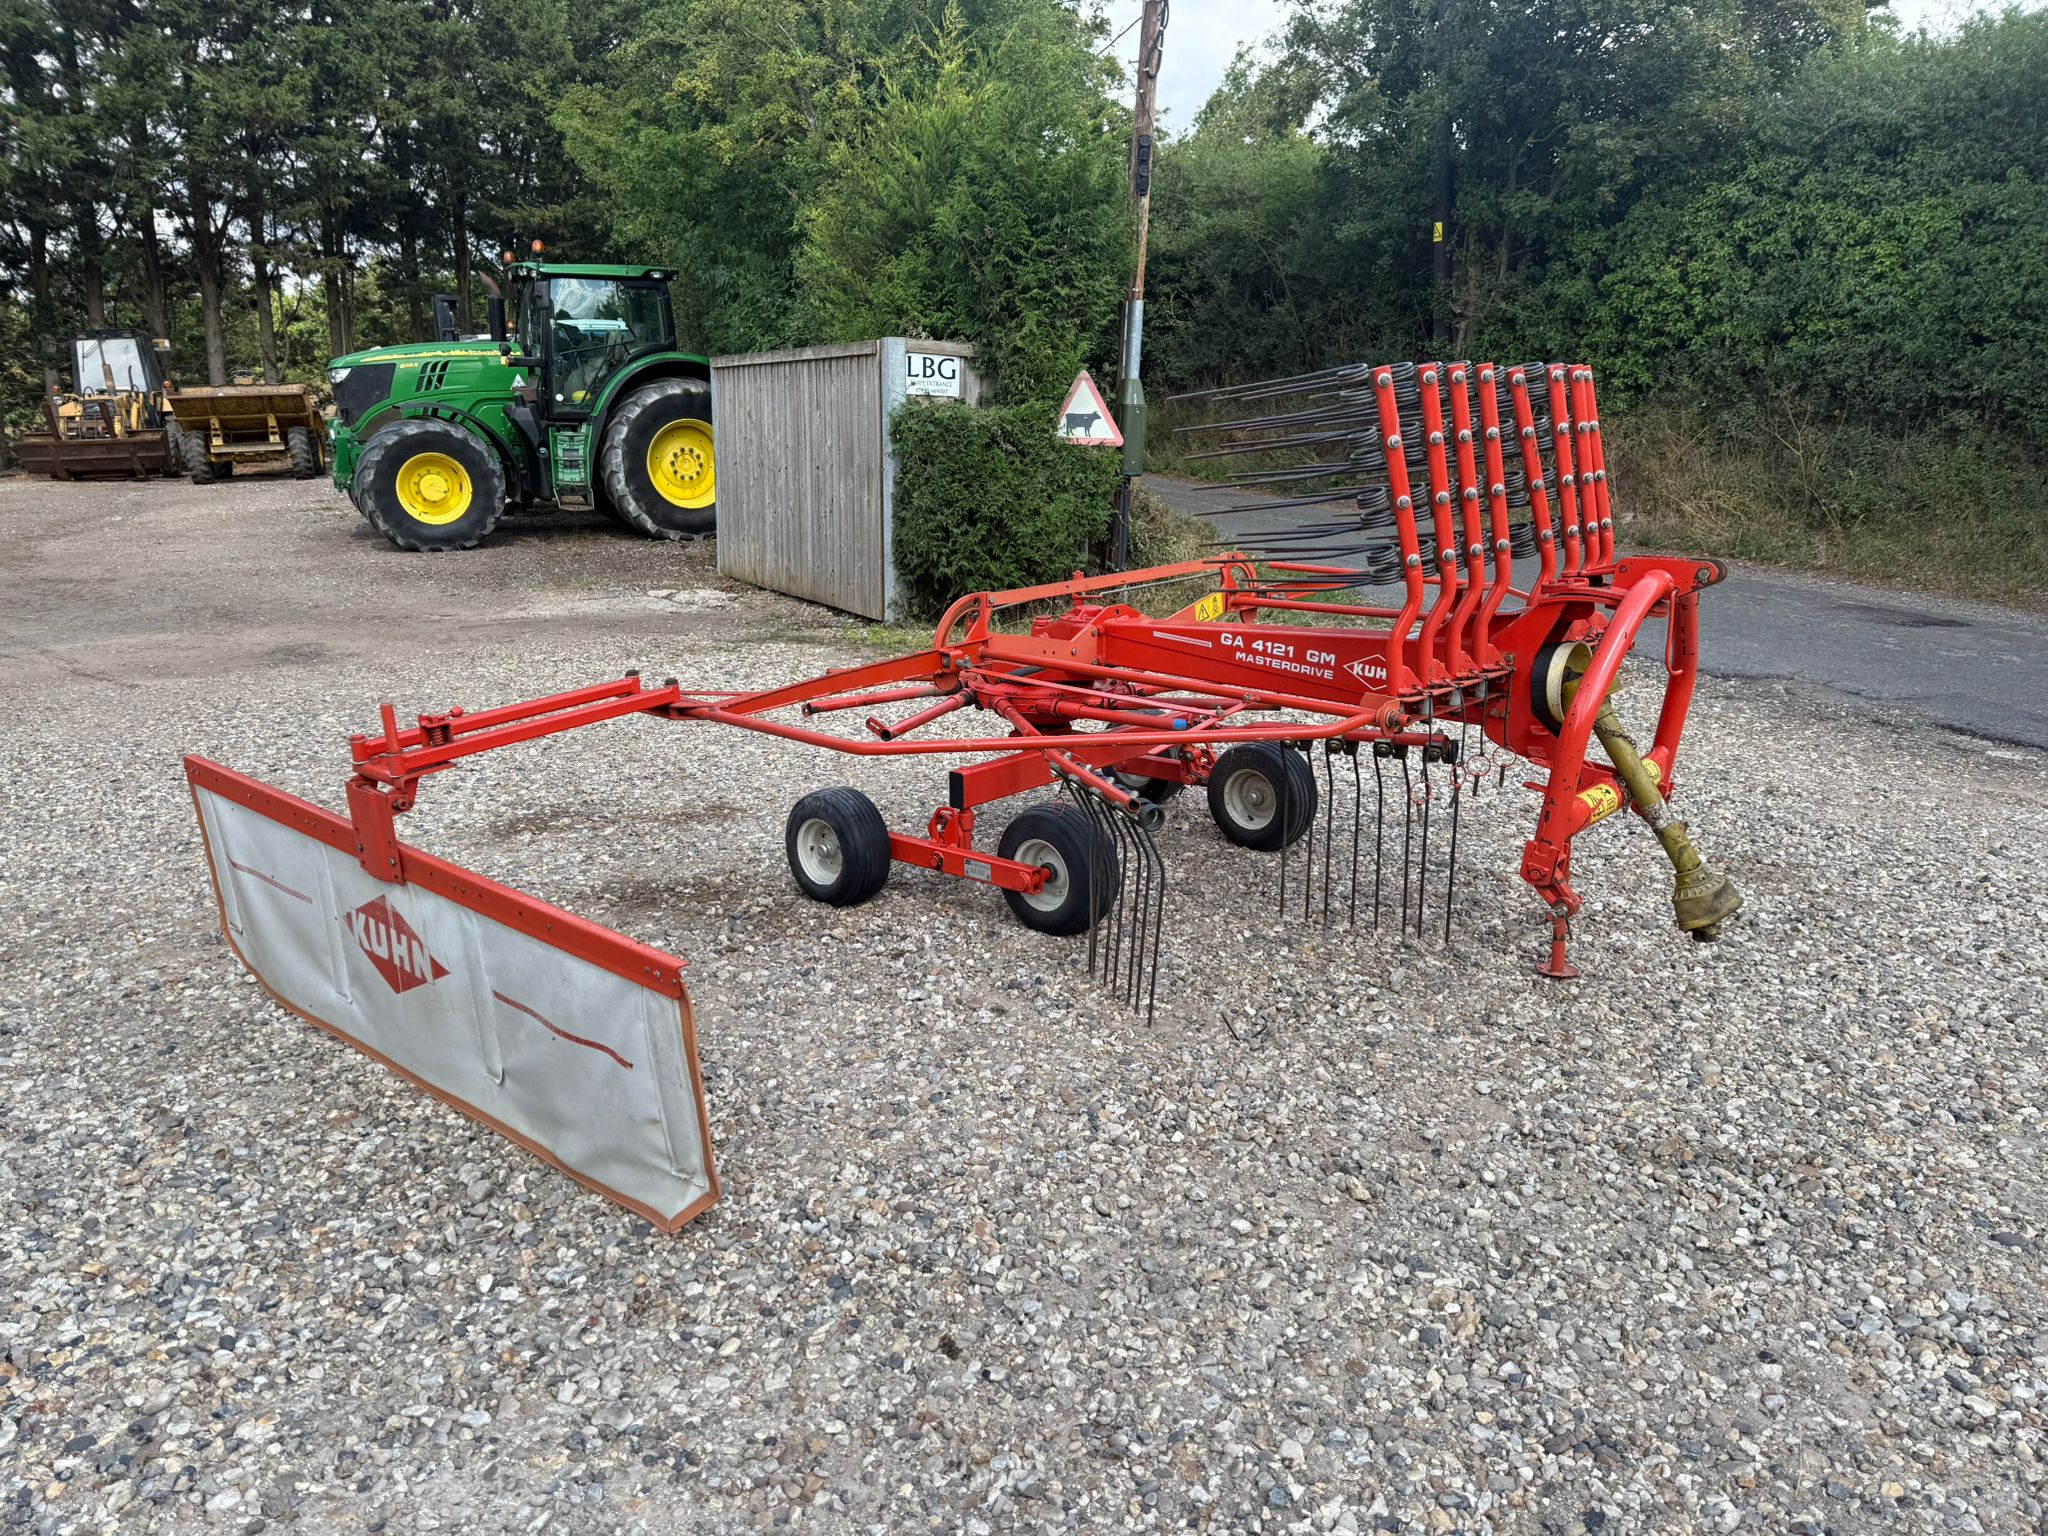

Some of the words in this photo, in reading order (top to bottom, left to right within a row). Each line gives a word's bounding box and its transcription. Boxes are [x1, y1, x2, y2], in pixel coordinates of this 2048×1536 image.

[907, 355, 956, 380] LBG
[1220, 632, 1244, 648] GA
[1251, 640, 1294, 658] 4121
[1306, 649, 1336, 666] GM
[1235, 651, 1334, 680] MASTERDRIVE
[1353, 662, 1387, 680] KUH
[350, 907, 435, 985] KUHN
